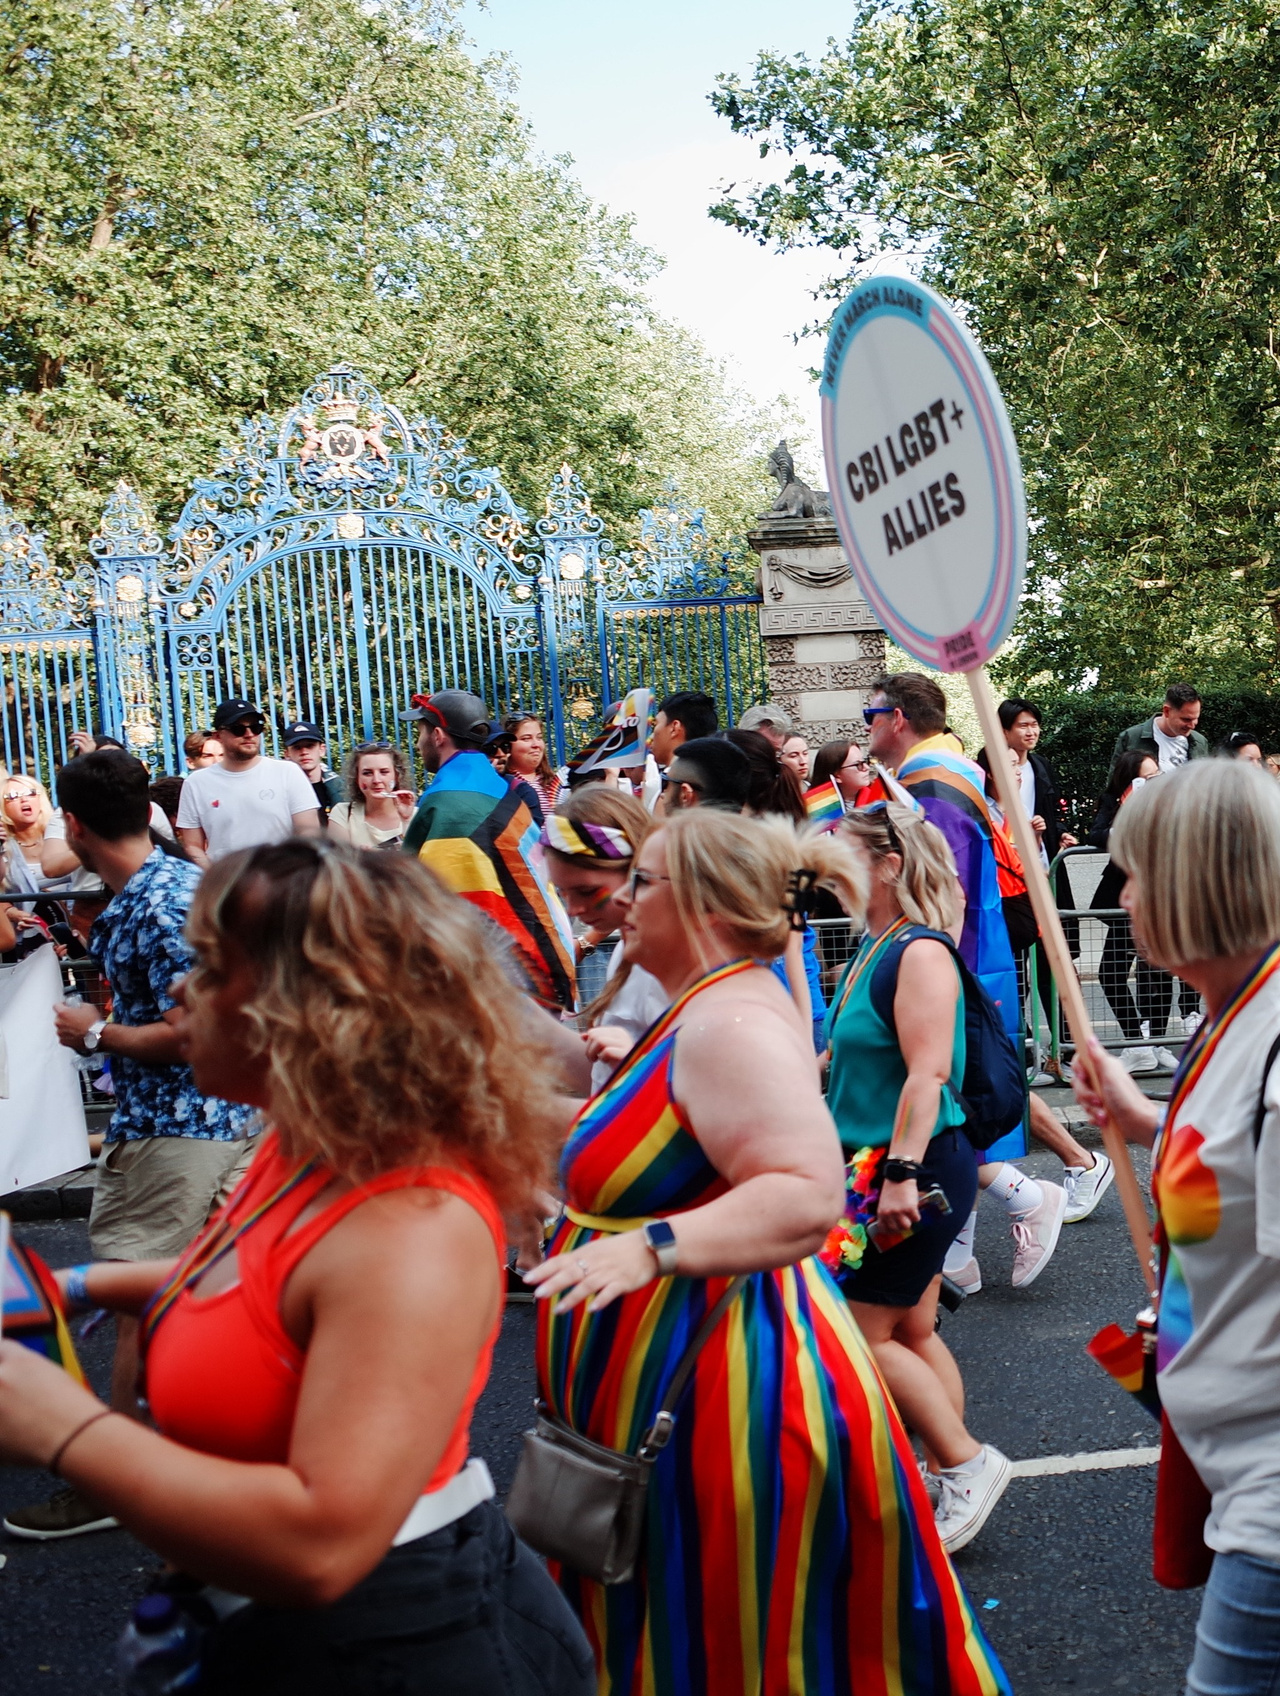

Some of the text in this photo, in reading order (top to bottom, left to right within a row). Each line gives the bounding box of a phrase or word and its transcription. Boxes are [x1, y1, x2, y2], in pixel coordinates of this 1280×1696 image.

[826, 286, 923, 388] NEVER MARCH ALONE
[846, 398, 964, 504] CBI LGBT+
[882, 472, 966, 557] ALLIES
